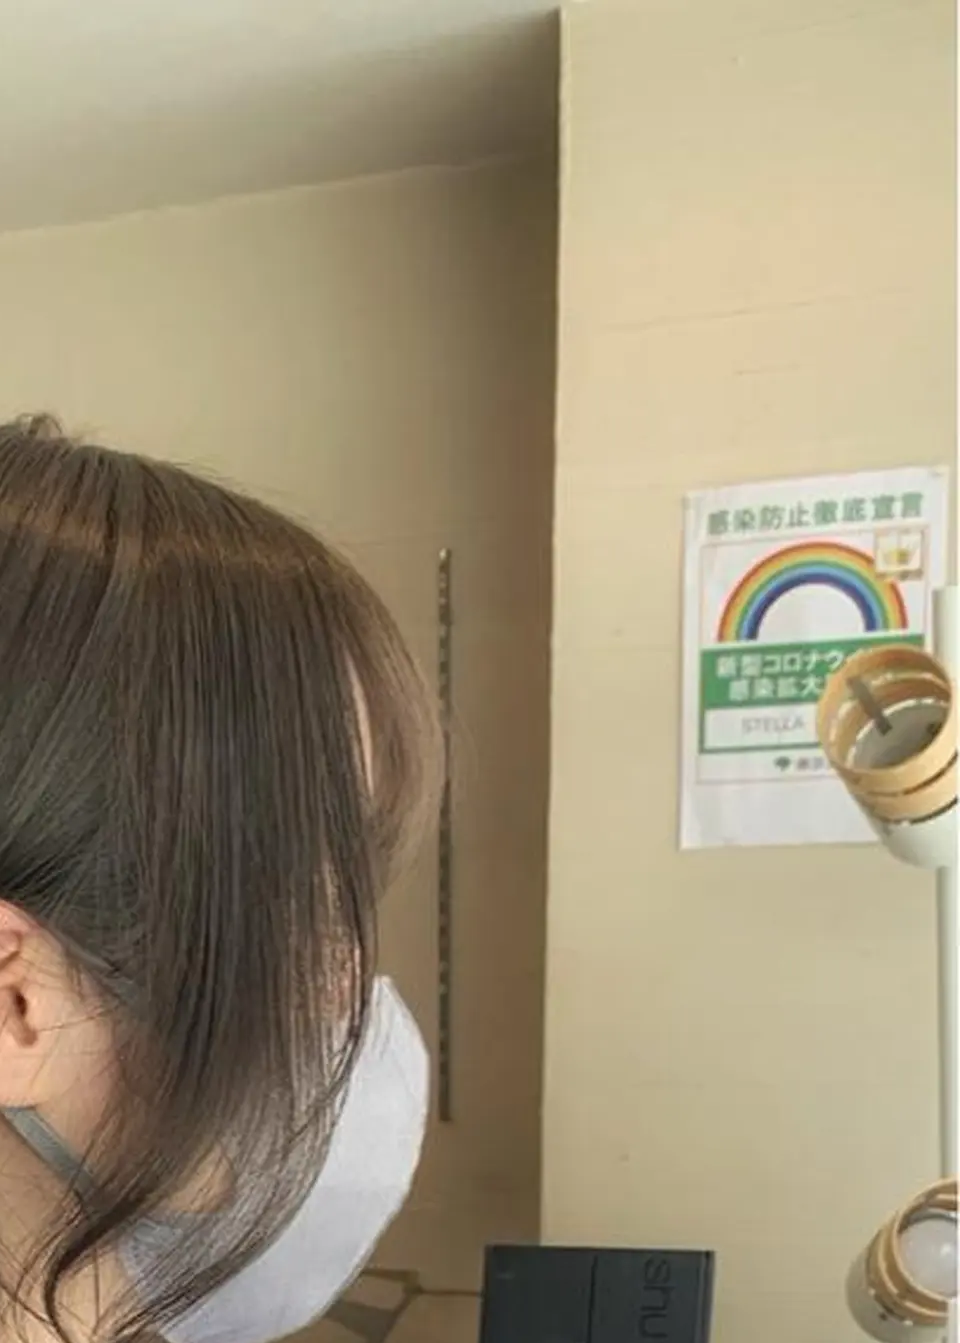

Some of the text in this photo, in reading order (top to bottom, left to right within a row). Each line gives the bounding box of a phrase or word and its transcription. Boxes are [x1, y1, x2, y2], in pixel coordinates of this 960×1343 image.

[717, 648, 845, 679] 新型コロナウ
[728, 677, 825, 701] 感染拡大
[641, 1256, 676, 1338] shu
